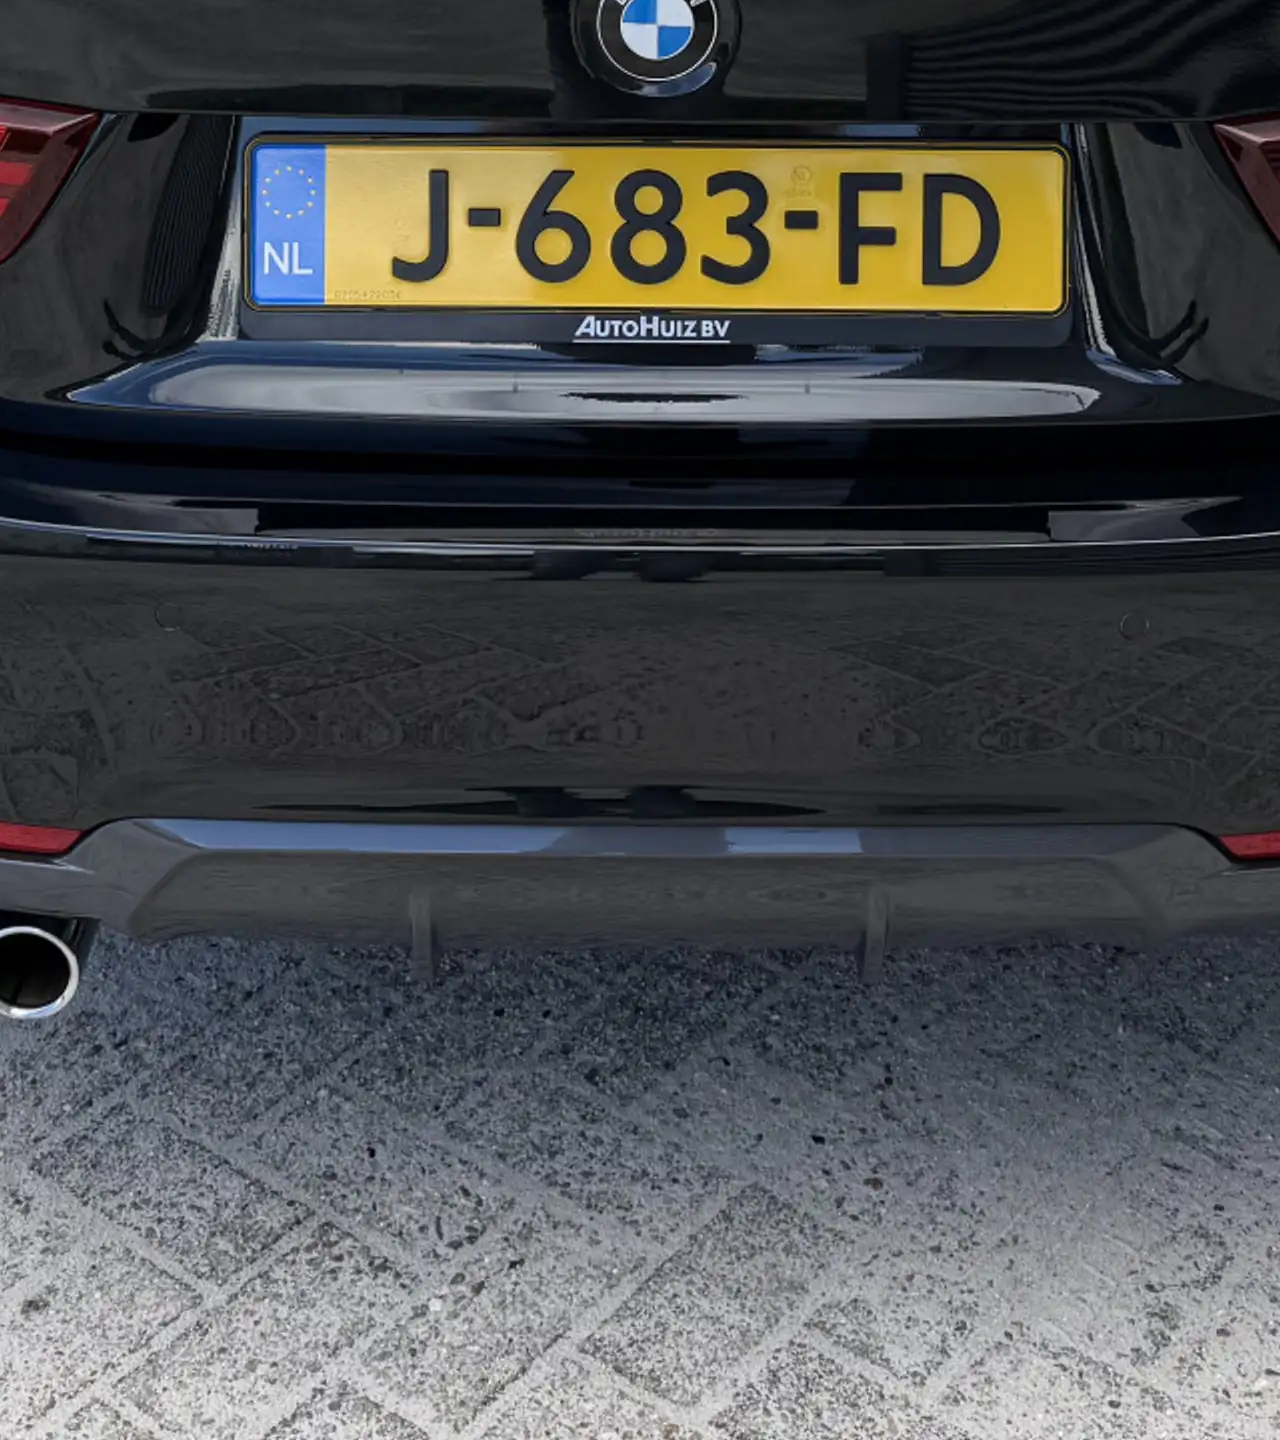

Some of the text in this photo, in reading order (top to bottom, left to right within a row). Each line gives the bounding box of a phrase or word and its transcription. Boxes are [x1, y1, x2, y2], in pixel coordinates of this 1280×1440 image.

[391, 169, 1001, 287] J-683-FD
[263, 243, 313, 276] NL
[700, 319, 731, 338] BV
